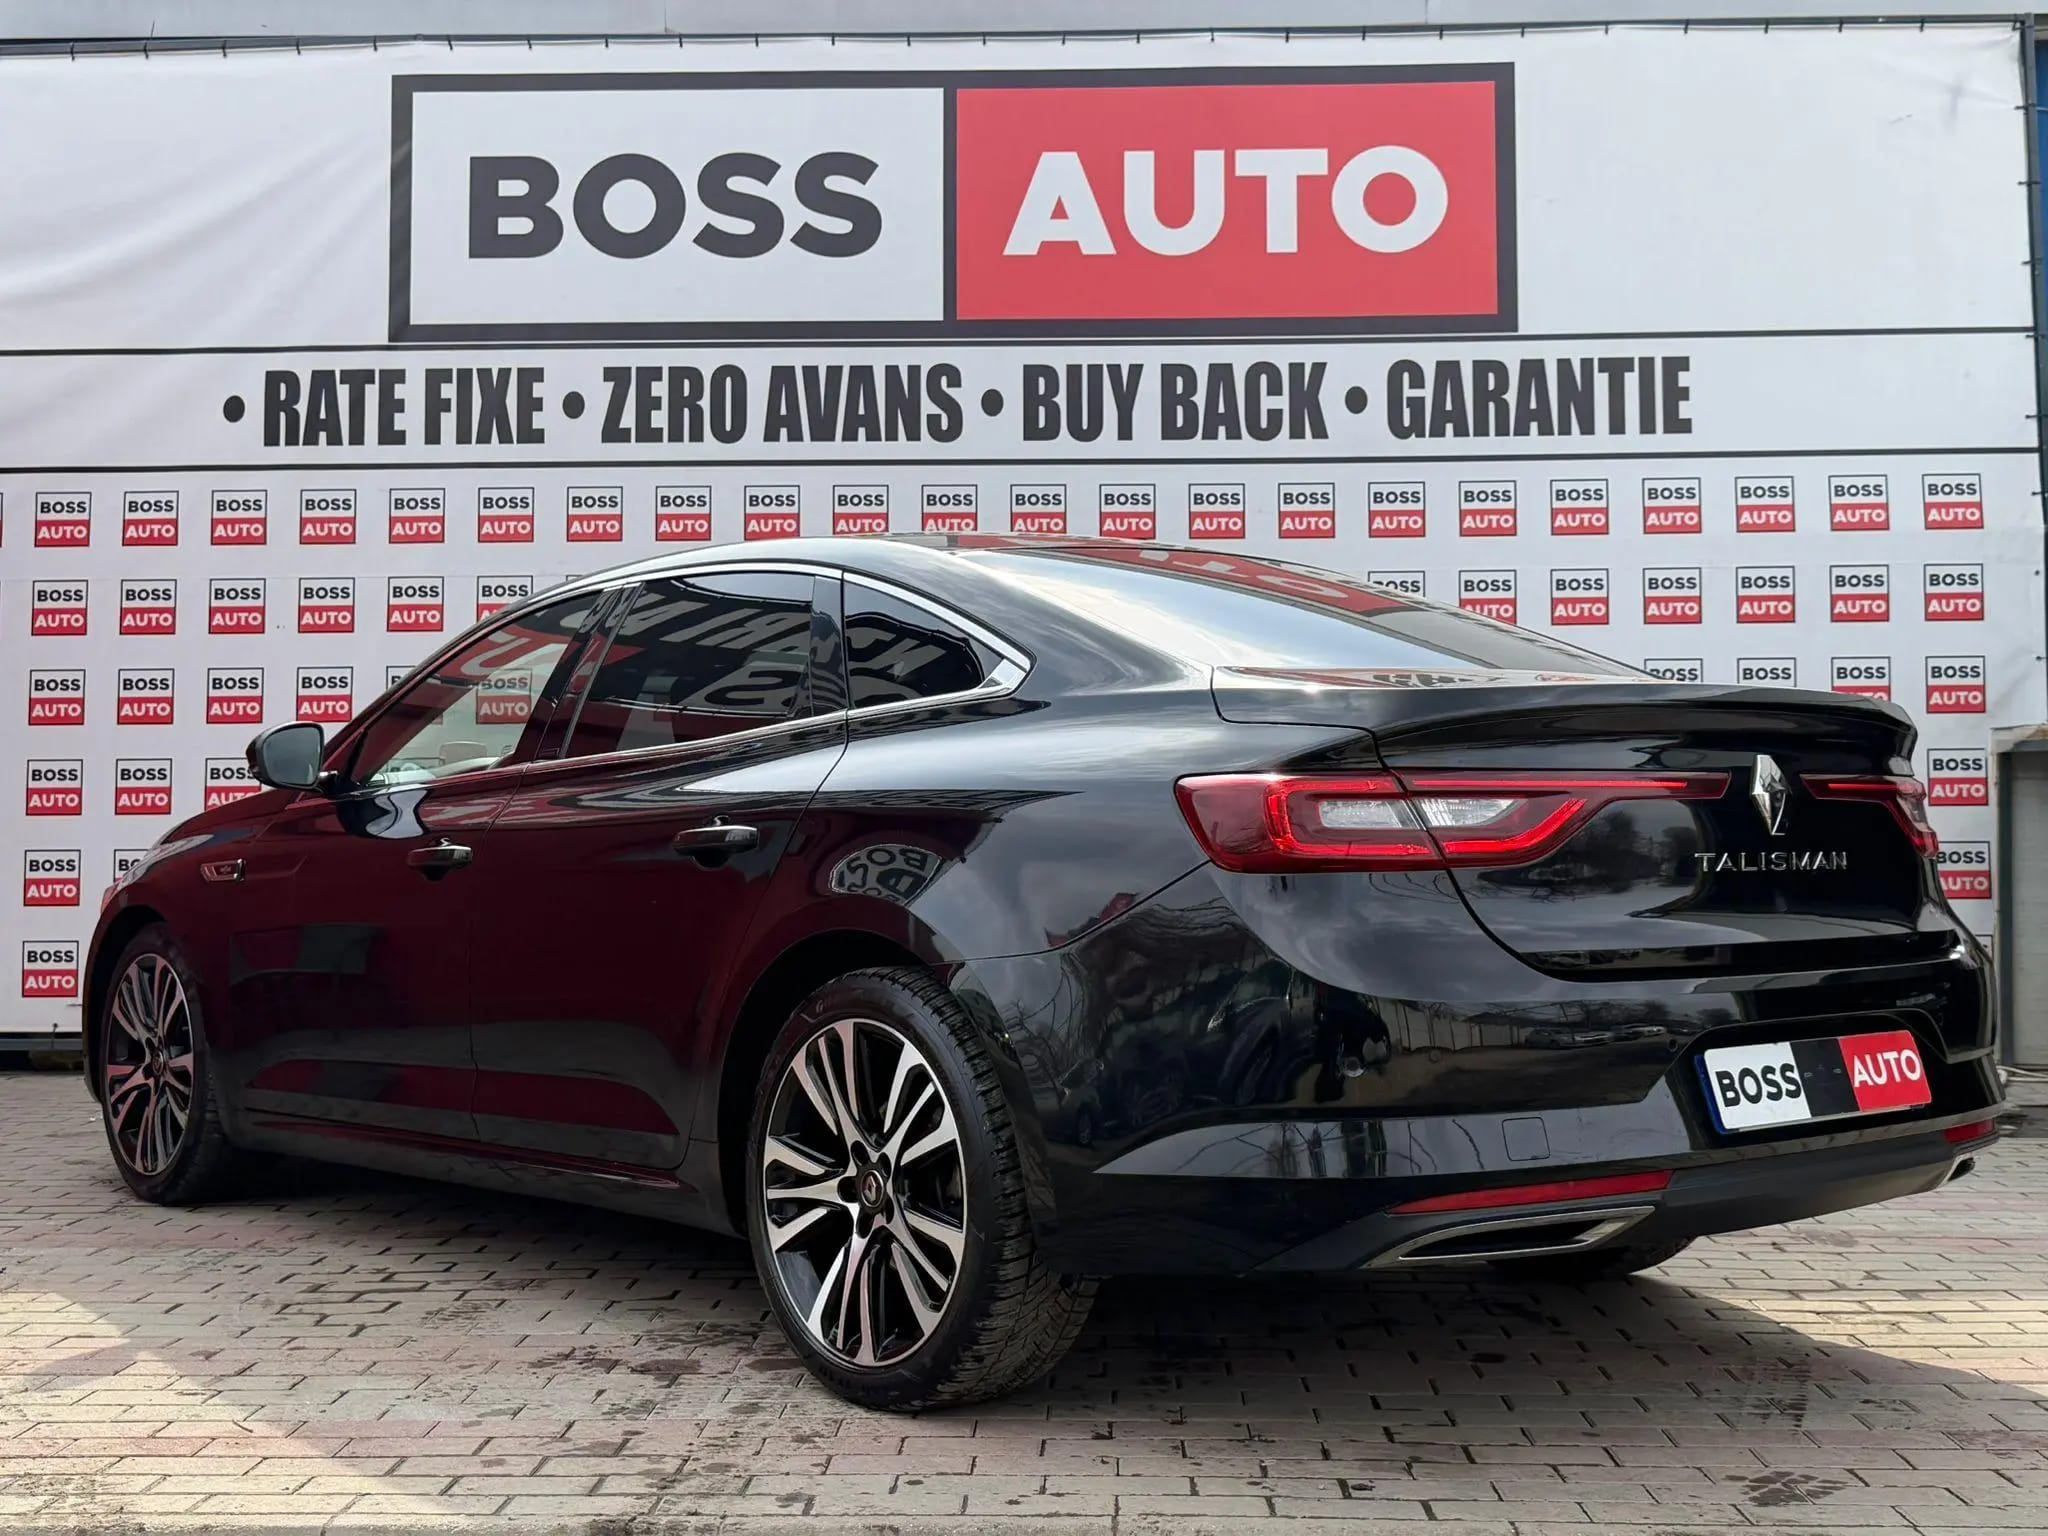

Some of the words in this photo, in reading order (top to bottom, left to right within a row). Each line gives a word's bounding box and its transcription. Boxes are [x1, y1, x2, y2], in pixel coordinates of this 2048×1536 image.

[469, 152, 882, 259] BOSS
[1003, 146, 1448, 255] AUTO
[264, 369, 406, 447] RATE
[424, 367, 545, 445] FIXE
[601, 363, 747, 444] ZERO
[763, 363, 963, 443] AVANS
[1023, 363, 1144, 442] BUY
[1161, 361, 1329, 440] BACK
[1387, 356, 1692, 439] GARANTIE
[1557, 489, 1603, 501] BOSS
[1648, 487, 1696, 499] BOSS
[1740, 486, 1789, 498] BOSS
[1834, 484, 1883, 497] BOSS
[1928, 483, 1977, 495] BOSS
[572, 496, 618, 508] BOSS
[661, 495, 707, 507] BOSS
[749, 495, 795, 507] BOSS
[838, 494, 884, 506] BOSS
[927, 494, 973, 506] BOSS
[1016, 494, 1062, 505] BOSS
[1105, 493, 1151, 505] BOSS
[1194, 493, 1240, 505] BOSS
[1284, 492, 1330, 504] BOSS
[1374, 491, 1420, 504] BOSS
[1466, 490, 1512, 502] BOSS
[40, 501, 86, 513] BOSS
[128, 500, 174, 512] BOSS
[216, 499, 262, 511] BOSS
[306, 499, 352, 510] BOSS
[394, 498, 440, 510] BOSS
[483, 497, 529, 509] BOSS
[1556, 514, 1606, 526] AUTO
[1646, 512, 1698, 525] AUTO
[1740, 511, 1792, 523] AUTO
[1834, 509, 1886, 522] AUTO
[1928, 508, 1979, 522] AUTO
[480, 521, 530, 534] AUTO
[569, 521, 619, 533] AUTO
[658, 520, 708, 532] AUTO
[746, 519, 796, 532] AUTO
[836, 519, 886, 532] AUTO
[925, 518, 975, 532] AUTO
[1013, 519, 1063, 531] AUTO
[1102, 518, 1152, 530] AUTO
[1192, 518, 1242, 530] AUTO
[1282, 517, 1332, 529] AUTO
[1372, 516, 1422, 529] AUTO
[1463, 515, 1513, 528] AUTO
[37, 526, 87, 538] AUTO
[125, 525, 175, 537] AUTO
[213, 524, 263, 536] AUTO
[303, 523, 353, 536] AUTO
[391, 522, 441, 535] AUTO
[1558, 578, 1604, 591] BOSS
[1648, 577, 1697, 589] BOSS
[1742, 576, 1790, 588] BOSS
[1836, 575, 1884, 587] BOSS
[1930, 573, 1979, 586] BOSS
[393, 586, 439, 598] BOSS
[482, 585, 528, 597] BOSS
[1466, 580, 1512, 592] BOSS
[37, 589, 83, 602] BOSS
[125, 589, 171, 601] BOSS
[215, 588, 261, 600] BOSS
[304, 587, 350, 599] BOSS
[1556, 603, 1606, 616] AUTO
[1648, 602, 1699, 616] AUTO
[1738, 602, 1790, 614] AUTO
[1834, 600, 1885, 612] AUTO
[1928, 599, 1979, 612] AUTO
[34, 614, 84, 627] AUTO
[122, 613, 172, 626] AUTO
[212, 613, 262, 625] AUTO
[301, 612, 351, 624] AUTO
[390, 610, 440, 623] AUTO
[1742, 668, 1791, 680] BOSS
[1838, 667, 1886, 679] BOSS
[1932, 666, 1980, 678] BOSS
[34, 679, 80, 691] BOSS
[123, 678, 169, 690] BOSS
[213, 677, 259, 689] BOSS
[302, 676, 348, 688] BOSS
[1930, 692, 1981, 704] AUTO
[31, 704, 81, 717] AUTO
[120, 703, 170, 716] AUTO
[210, 702, 260, 715] AUTO
[299, 701, 349, 714] AUTO
[480, 702, 529, 716] AUTO
[1934, 758, 1982, 771] BOSS
[32, 769, 78, 781] BOSS
[121, 768, 167, 780] BOSS
[1932, 784, 1983, 796] AUTO
[29, 794, 79, 807] AUTO
[118, 793, 168, 806] AUTO
[29, 859, 75, 872] BOSS
[1694, 851, 1848, 872] TALISMAN
[27, 885, 77, 897] AUTO
[28, 950, 74, 963] BOSS
[25, 976, 75, 988] AUTO
[1715, 1062, 1803, 1107] BOSS
[1853, 1049, 1922, 1088] AUTO
